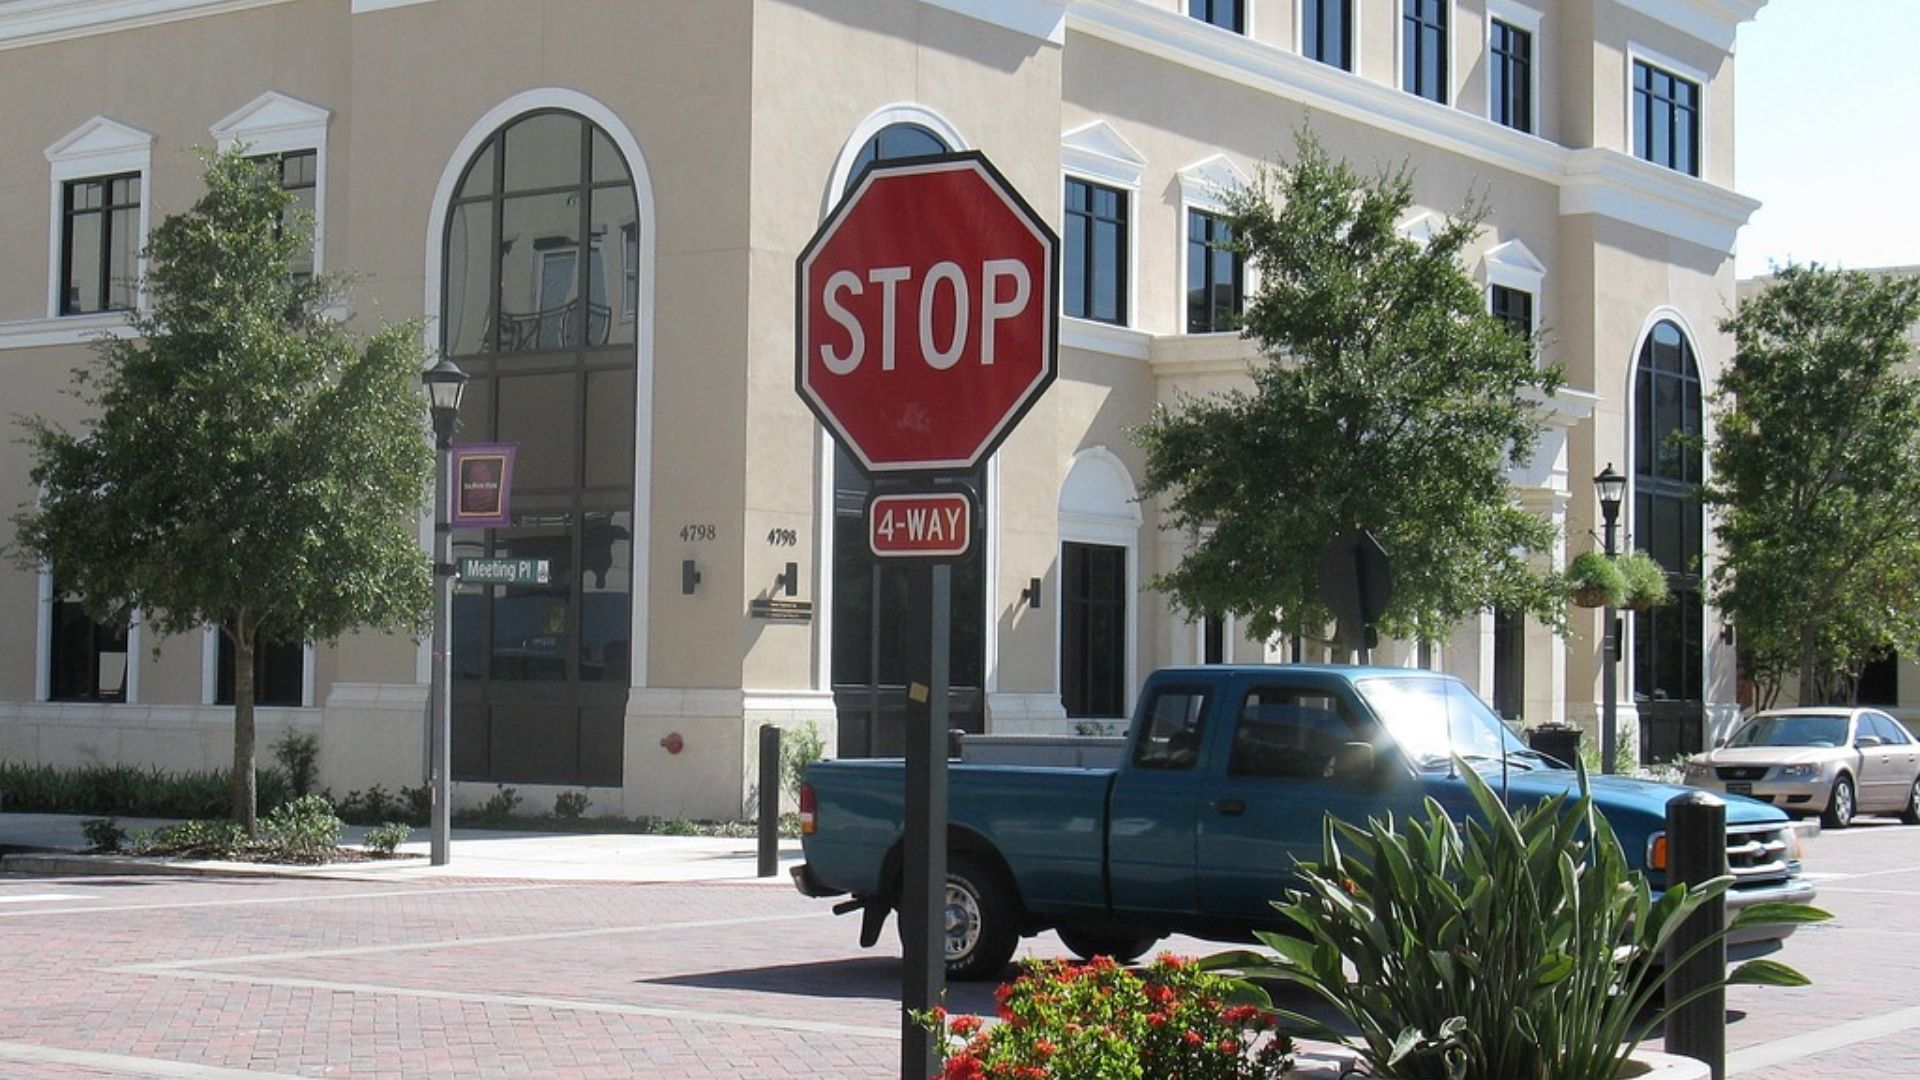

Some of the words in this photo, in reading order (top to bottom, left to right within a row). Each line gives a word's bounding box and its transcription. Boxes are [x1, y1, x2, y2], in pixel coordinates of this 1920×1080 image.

[820, 258, 1031, 375] STOP
[680, 524, 716, 542] 4798
[877, 507, 961, 542] 4-WAY
[766, 528, 797, 547] 4798
[467, 560, 516, 582] Meeting
[519, 560, 531, 579] Pl
